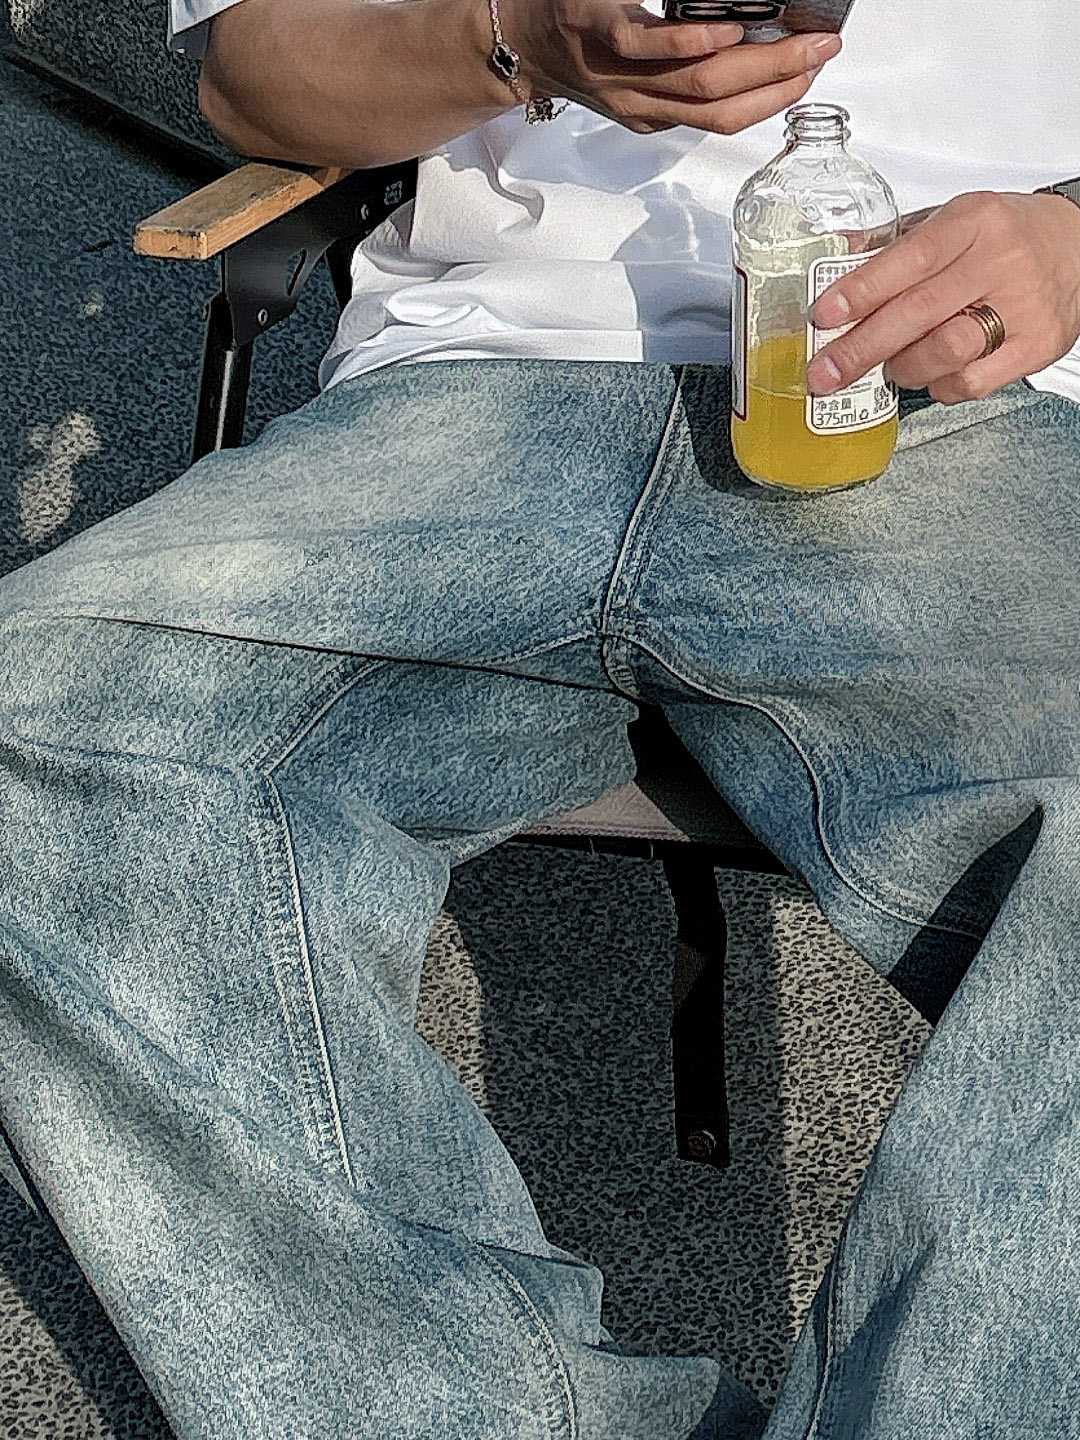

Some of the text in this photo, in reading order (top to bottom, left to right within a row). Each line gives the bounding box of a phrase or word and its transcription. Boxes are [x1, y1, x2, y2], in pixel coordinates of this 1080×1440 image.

[815, 398, 852, 412] 净含量
[815, 408, 857, 427] 375ml
